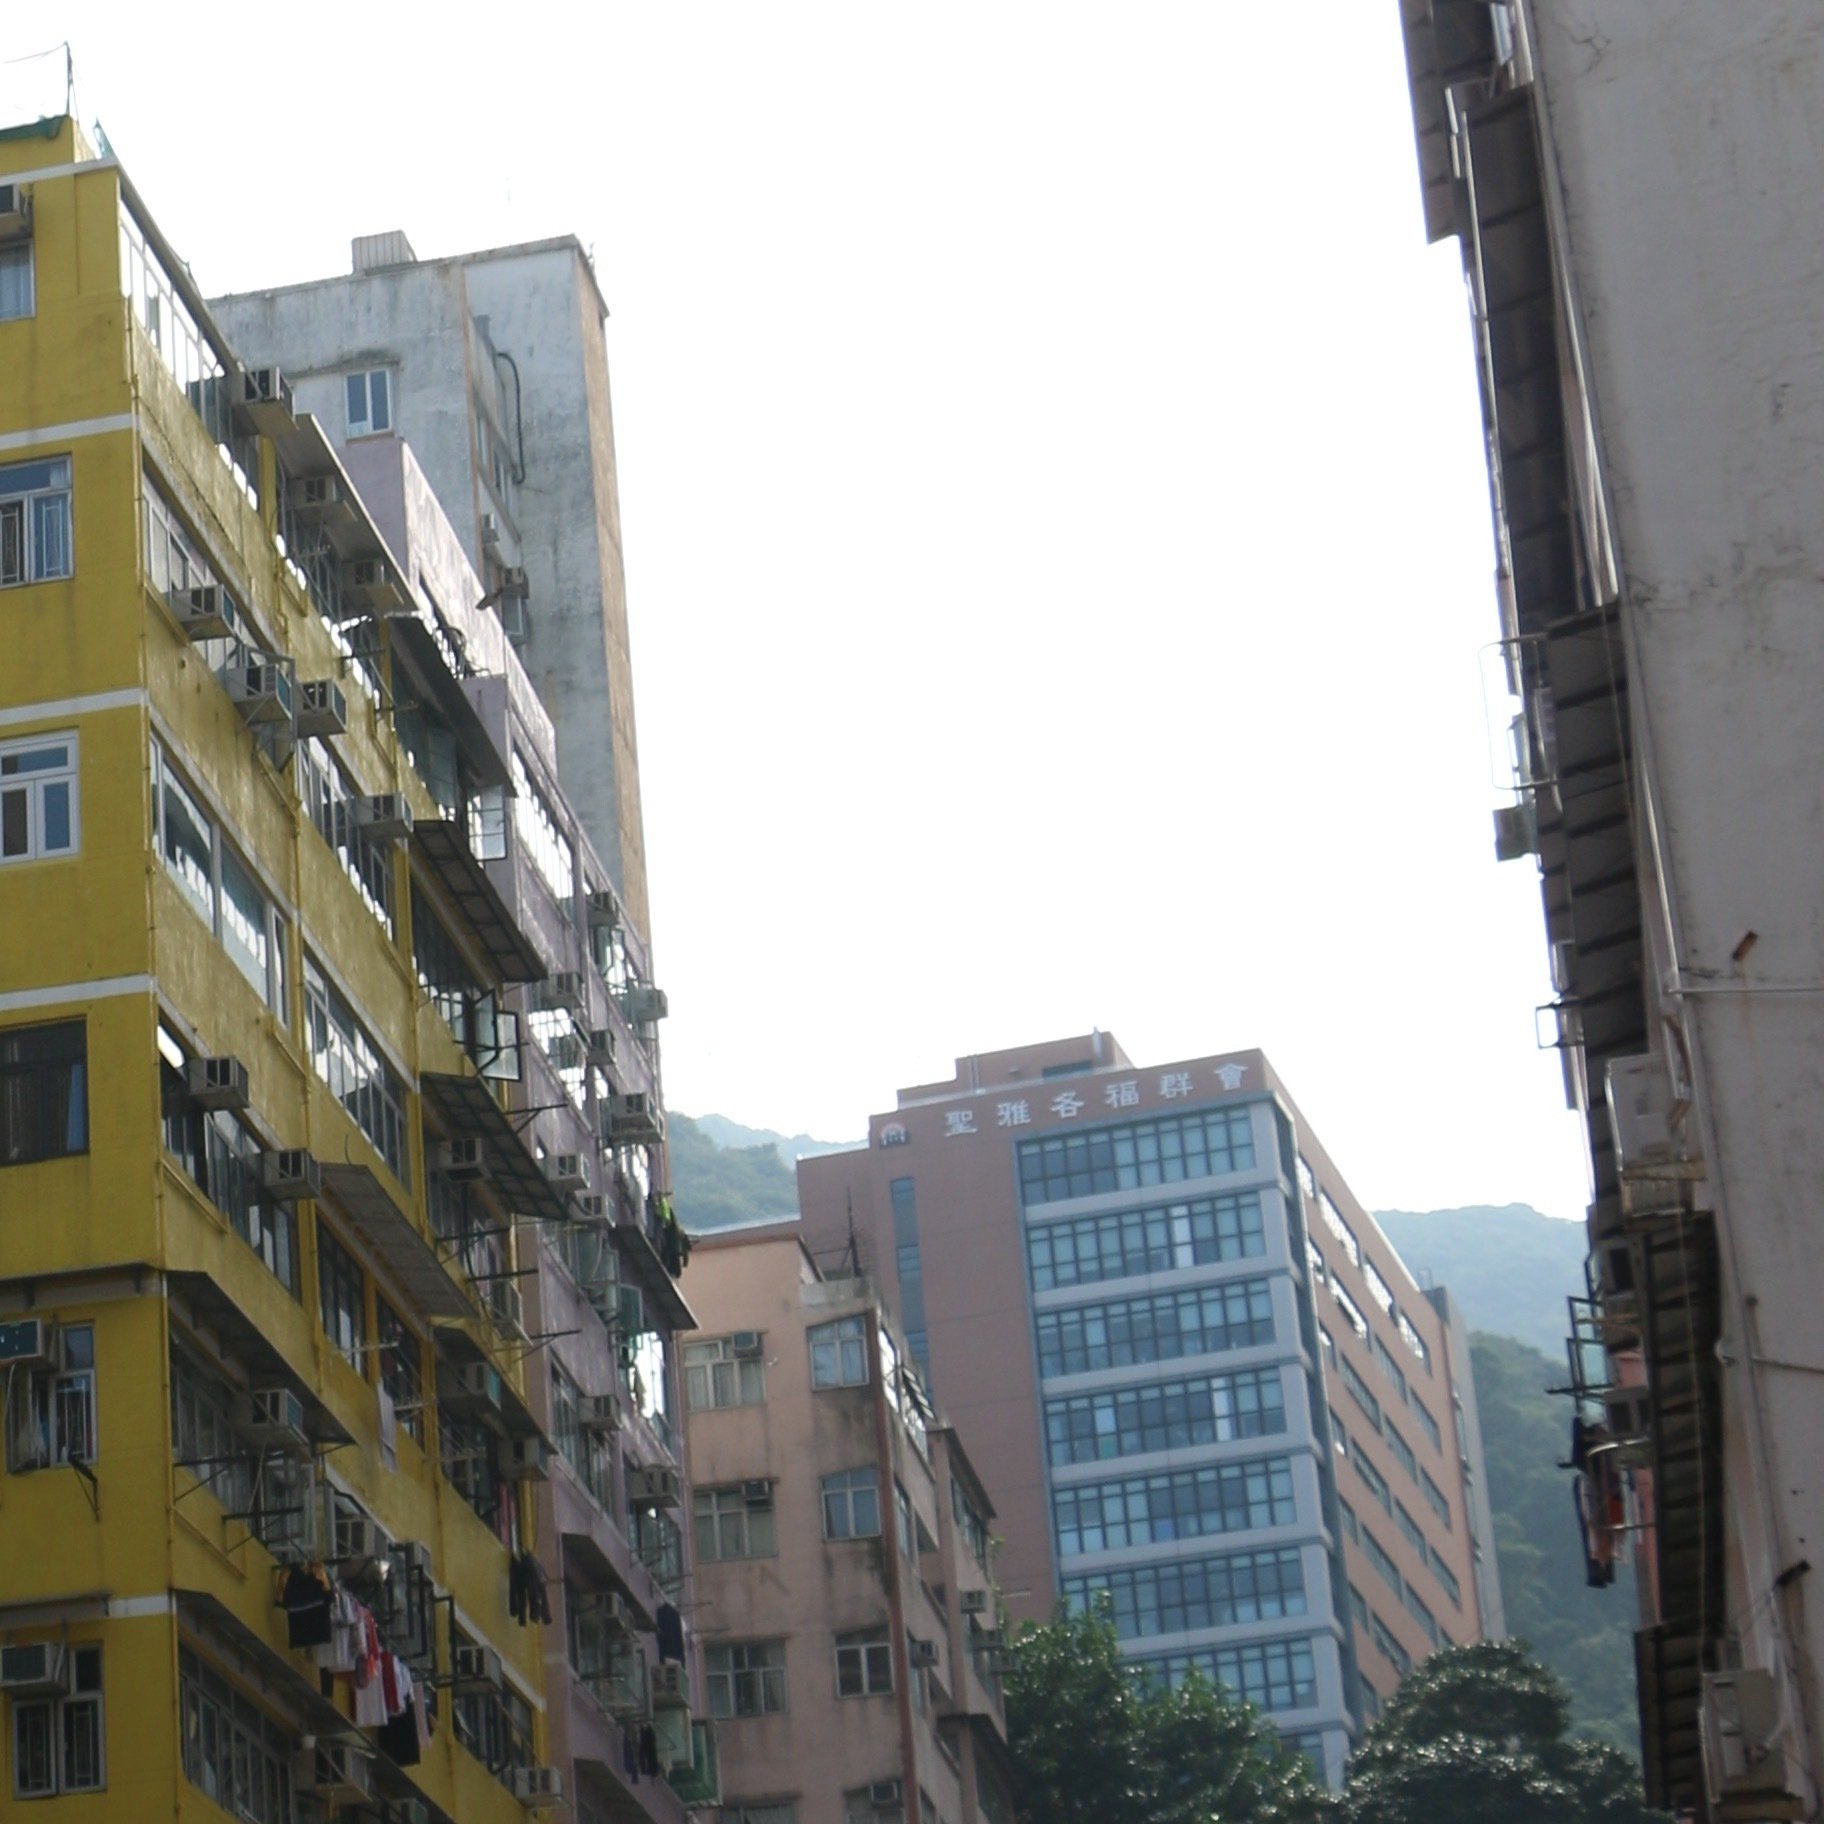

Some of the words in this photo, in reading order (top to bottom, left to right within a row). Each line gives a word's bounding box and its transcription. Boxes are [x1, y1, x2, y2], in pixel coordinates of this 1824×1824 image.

[944, 1063, 1248, 1138] 聖雅各福群會
